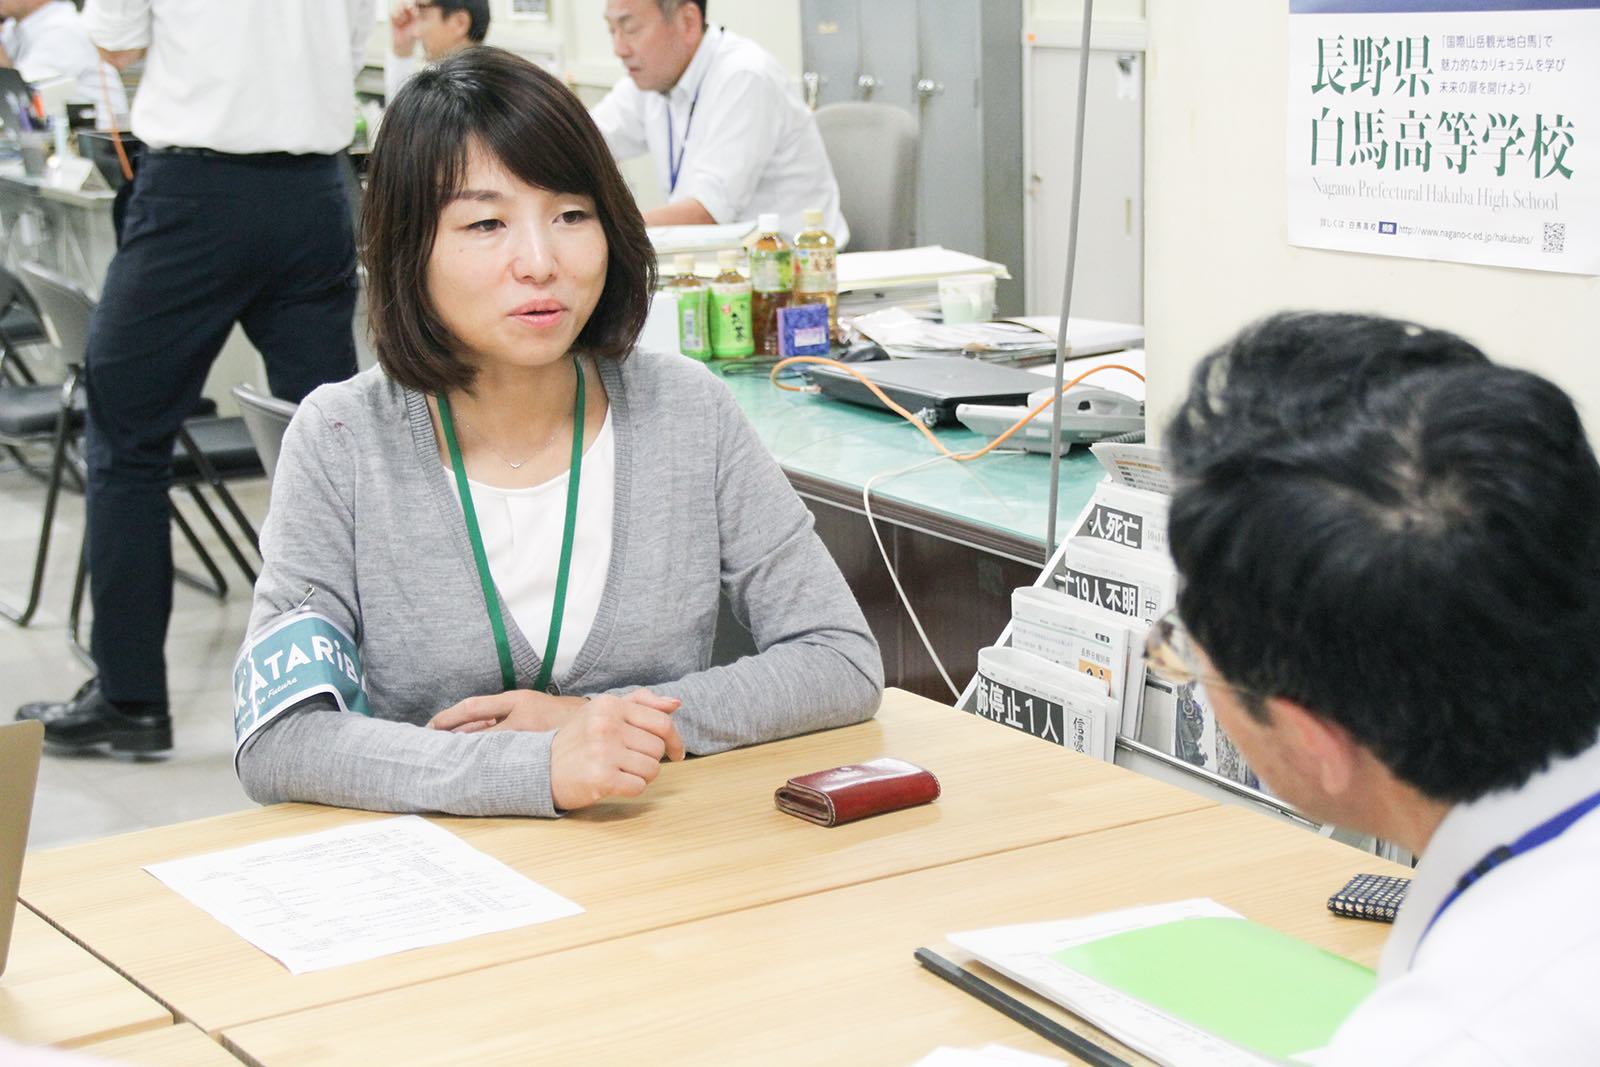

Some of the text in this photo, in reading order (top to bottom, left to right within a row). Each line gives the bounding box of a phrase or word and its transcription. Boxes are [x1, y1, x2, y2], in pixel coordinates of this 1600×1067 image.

[1311, 34, 1434, 97] 長野県
[1440, 58, 1566, 73] 魅力的なカリキュラムを学び
[1311, 106, 1575, 180] 白馬高等学校
[1312, 176, 1559, 213] Nagano Prefectural Hakuba High School
[1091, 508, 1139, 548] 人死亡
